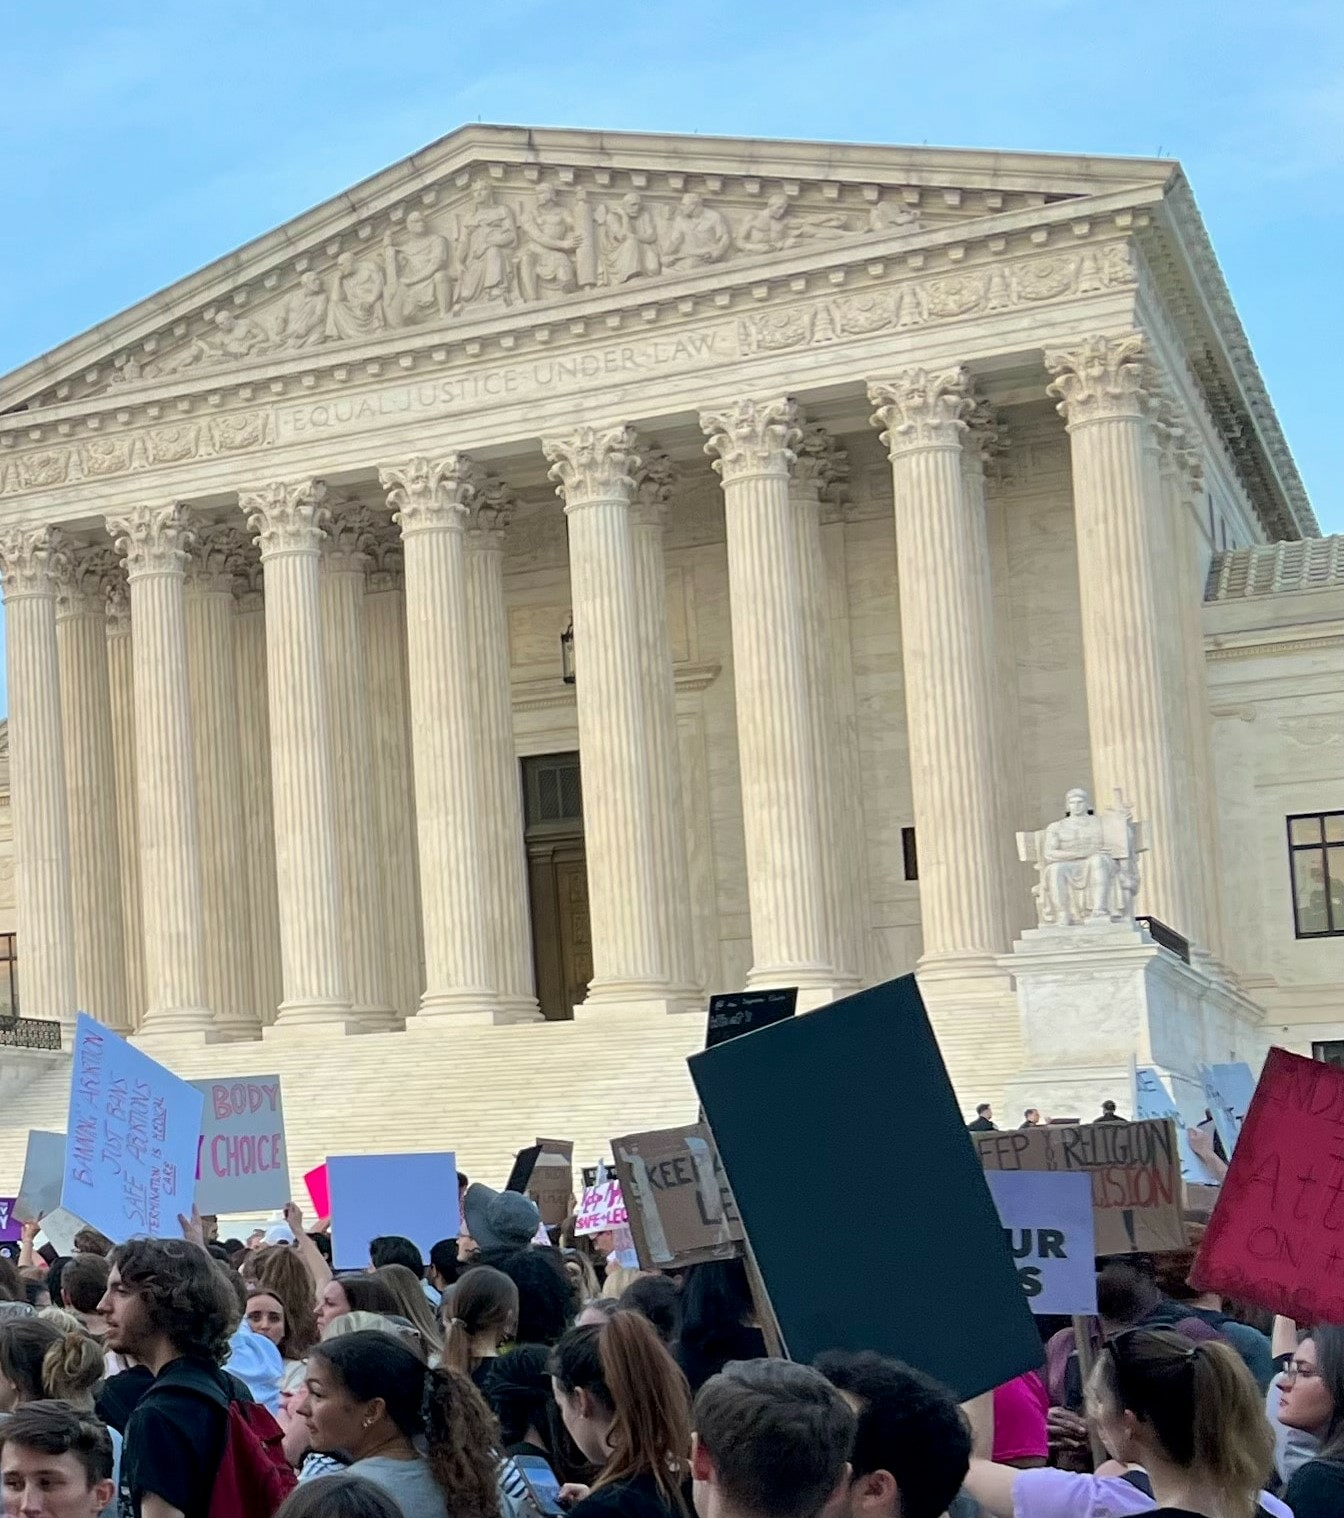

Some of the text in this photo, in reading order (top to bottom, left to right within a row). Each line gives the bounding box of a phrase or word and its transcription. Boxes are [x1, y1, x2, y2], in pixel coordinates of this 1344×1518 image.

[291, 332, 719, 432] EQUAL JUSTICE UNDER LAW
[80, 1028, 104, 1104] ABORTION
[212, 1083, 280, 1120] BODY
[100, 1122, 122, 1175] JUST
[122, 1079, 152, 1227] SAFE ABORTIONS
[211, 1134, 282, 1178] CHOICE
[977, 1134, 1030, 1171] EEP
[1061, 1120, 1174, 1168] RELIGION
[162, 1161, 176, 1196] CARE
[1092, 1167, 1174, 1208] ISION
